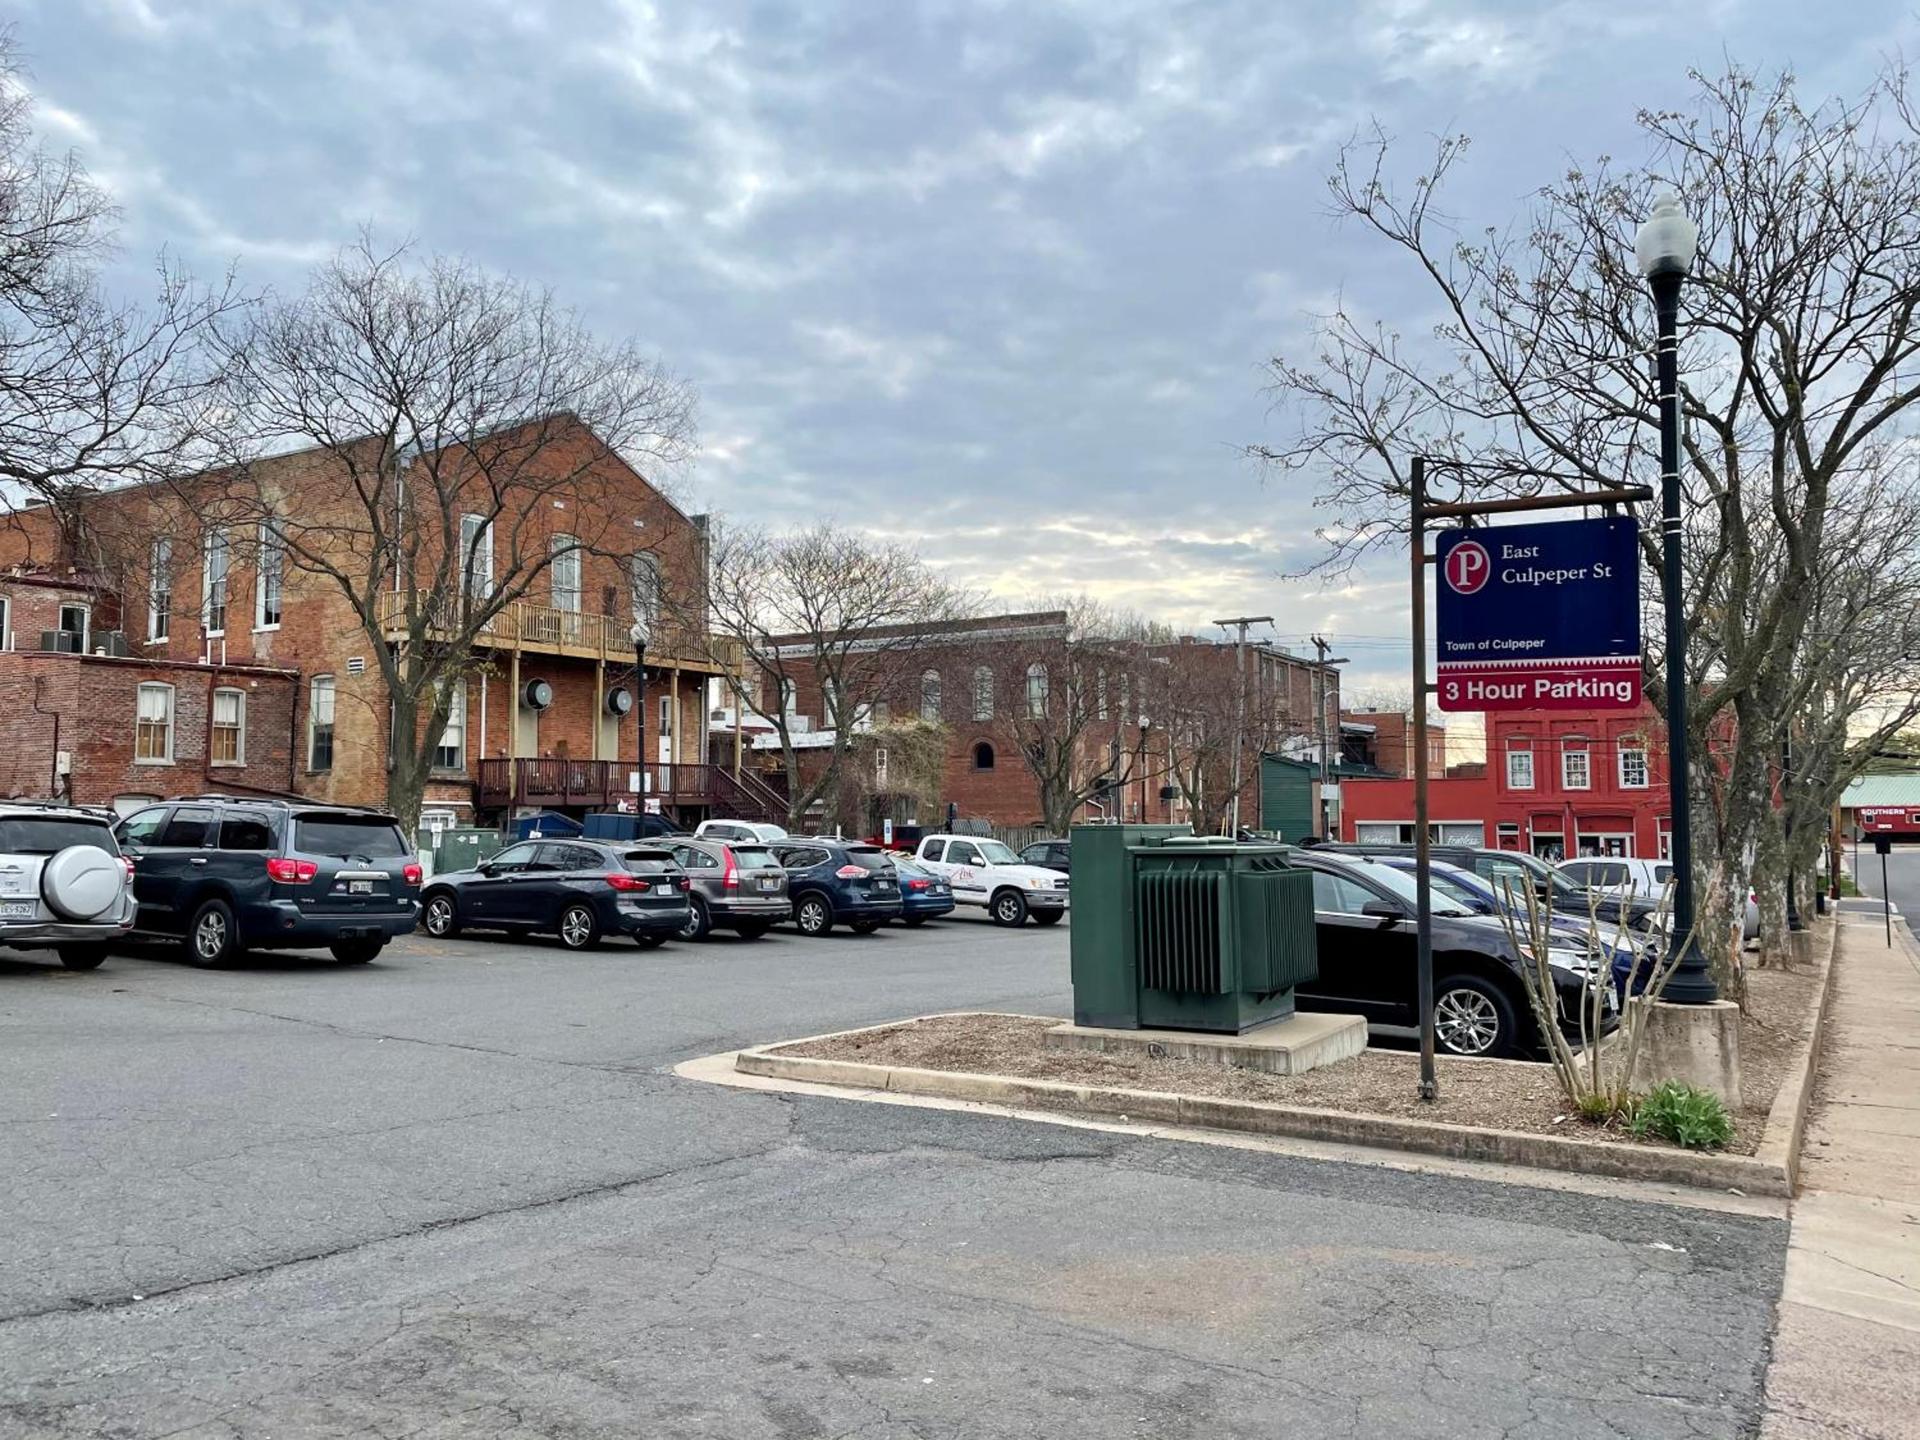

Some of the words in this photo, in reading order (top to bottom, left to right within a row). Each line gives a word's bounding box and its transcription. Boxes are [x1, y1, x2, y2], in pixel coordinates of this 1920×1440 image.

[1501, 544, 1539, 560] East
[1456, 550, 1483, 586] P
[1501, 567, 1587, 586] Culpeper
[1592, 562, 1612, 579] St
[1446, 641, 1476, 651] Town
[1478, 639, 1490, 650] of
[1492, 638, 1545, 650] Culpeper
[1446, 682, 1460, 700] 3
[1467, 681, 1526, 700] Hour
[1535, 678, 1632, 702] Parking
